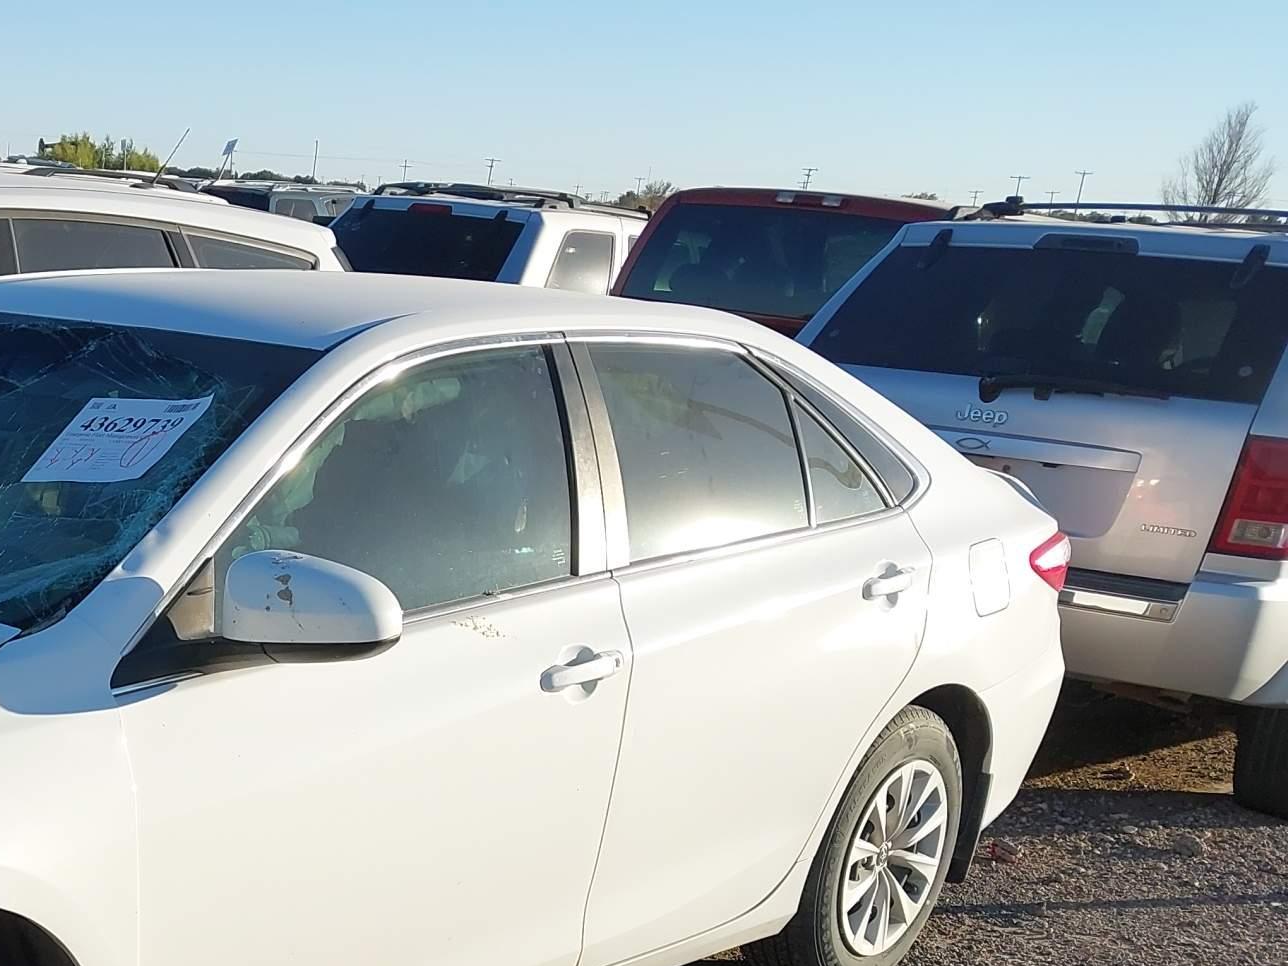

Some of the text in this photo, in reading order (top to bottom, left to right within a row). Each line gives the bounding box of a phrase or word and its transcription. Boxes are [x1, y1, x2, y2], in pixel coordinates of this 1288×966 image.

[956, 402, 1008, 427] Jeep
[80, 416, 184, 434] 43629739
[1140, 523, 1197, 538] LIMITED
